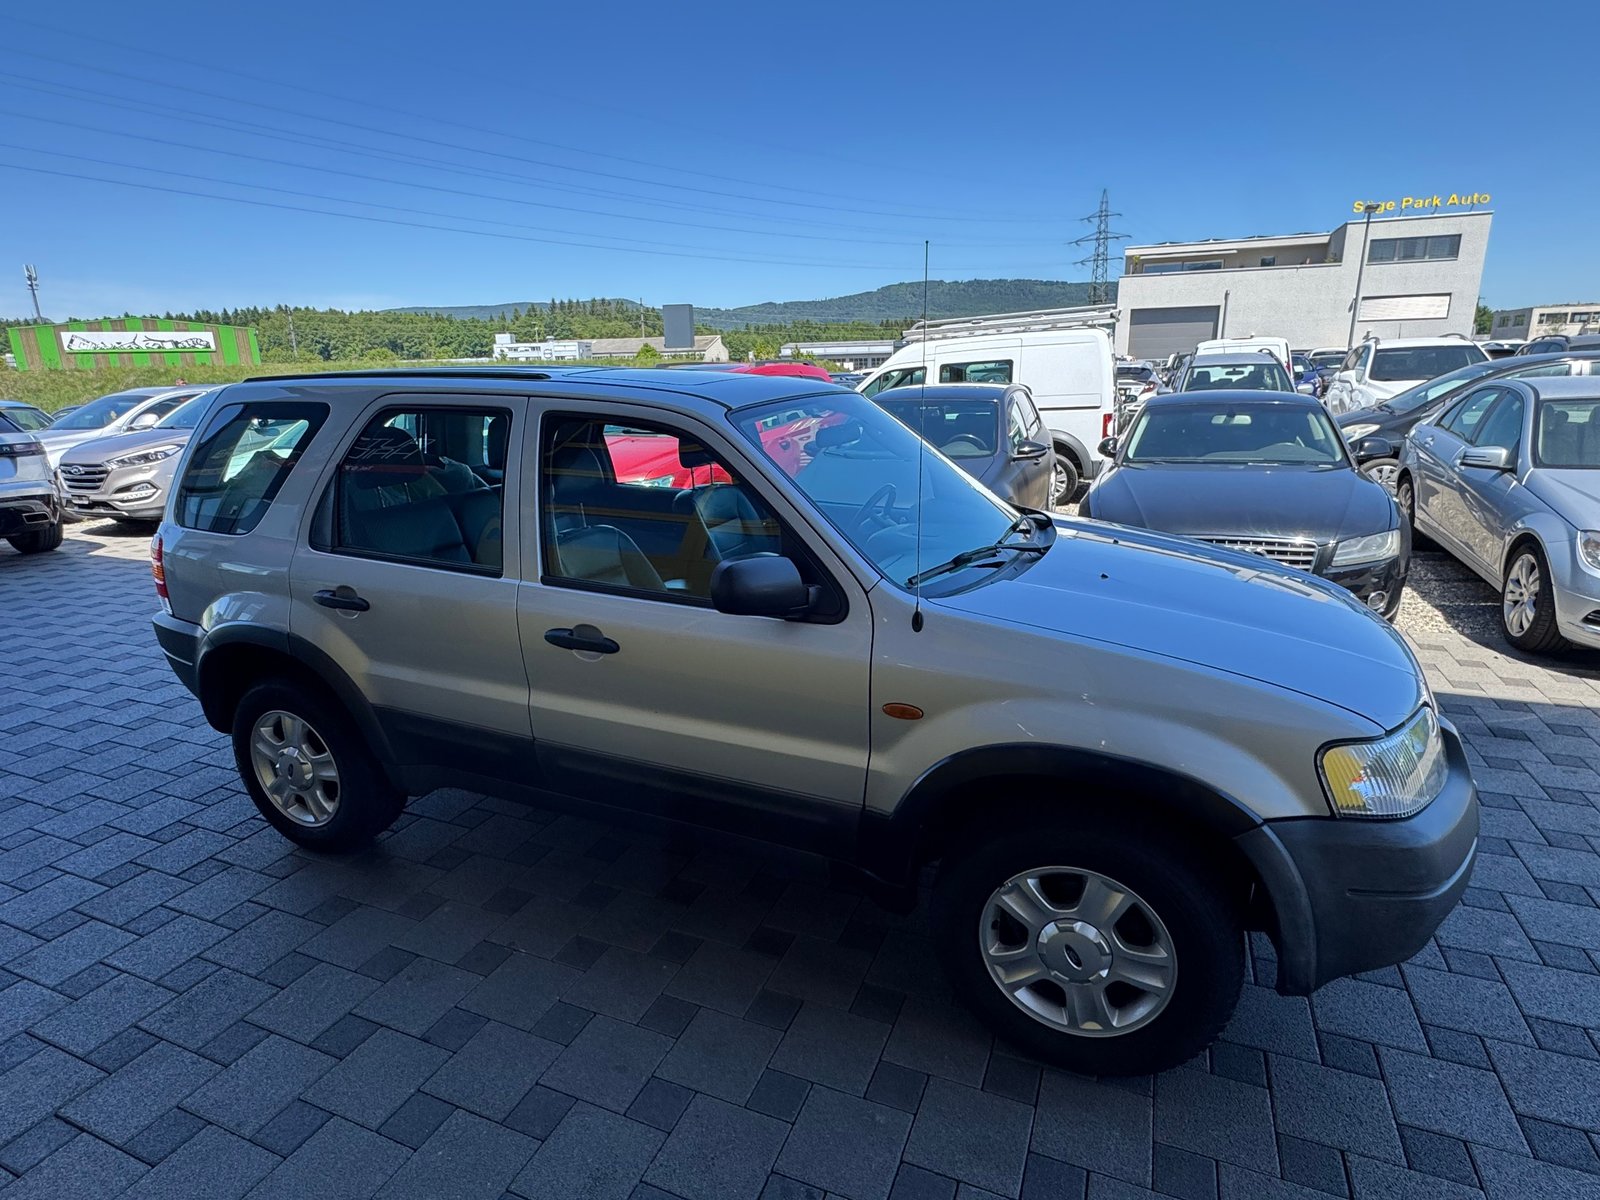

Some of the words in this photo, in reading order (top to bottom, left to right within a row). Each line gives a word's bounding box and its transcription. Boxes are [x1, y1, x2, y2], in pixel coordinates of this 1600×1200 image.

[1353, 200, 1395, 214] Sge
[1401, 195, 1442, 209] Park
[1447, 192, 1491, 206] Auto
